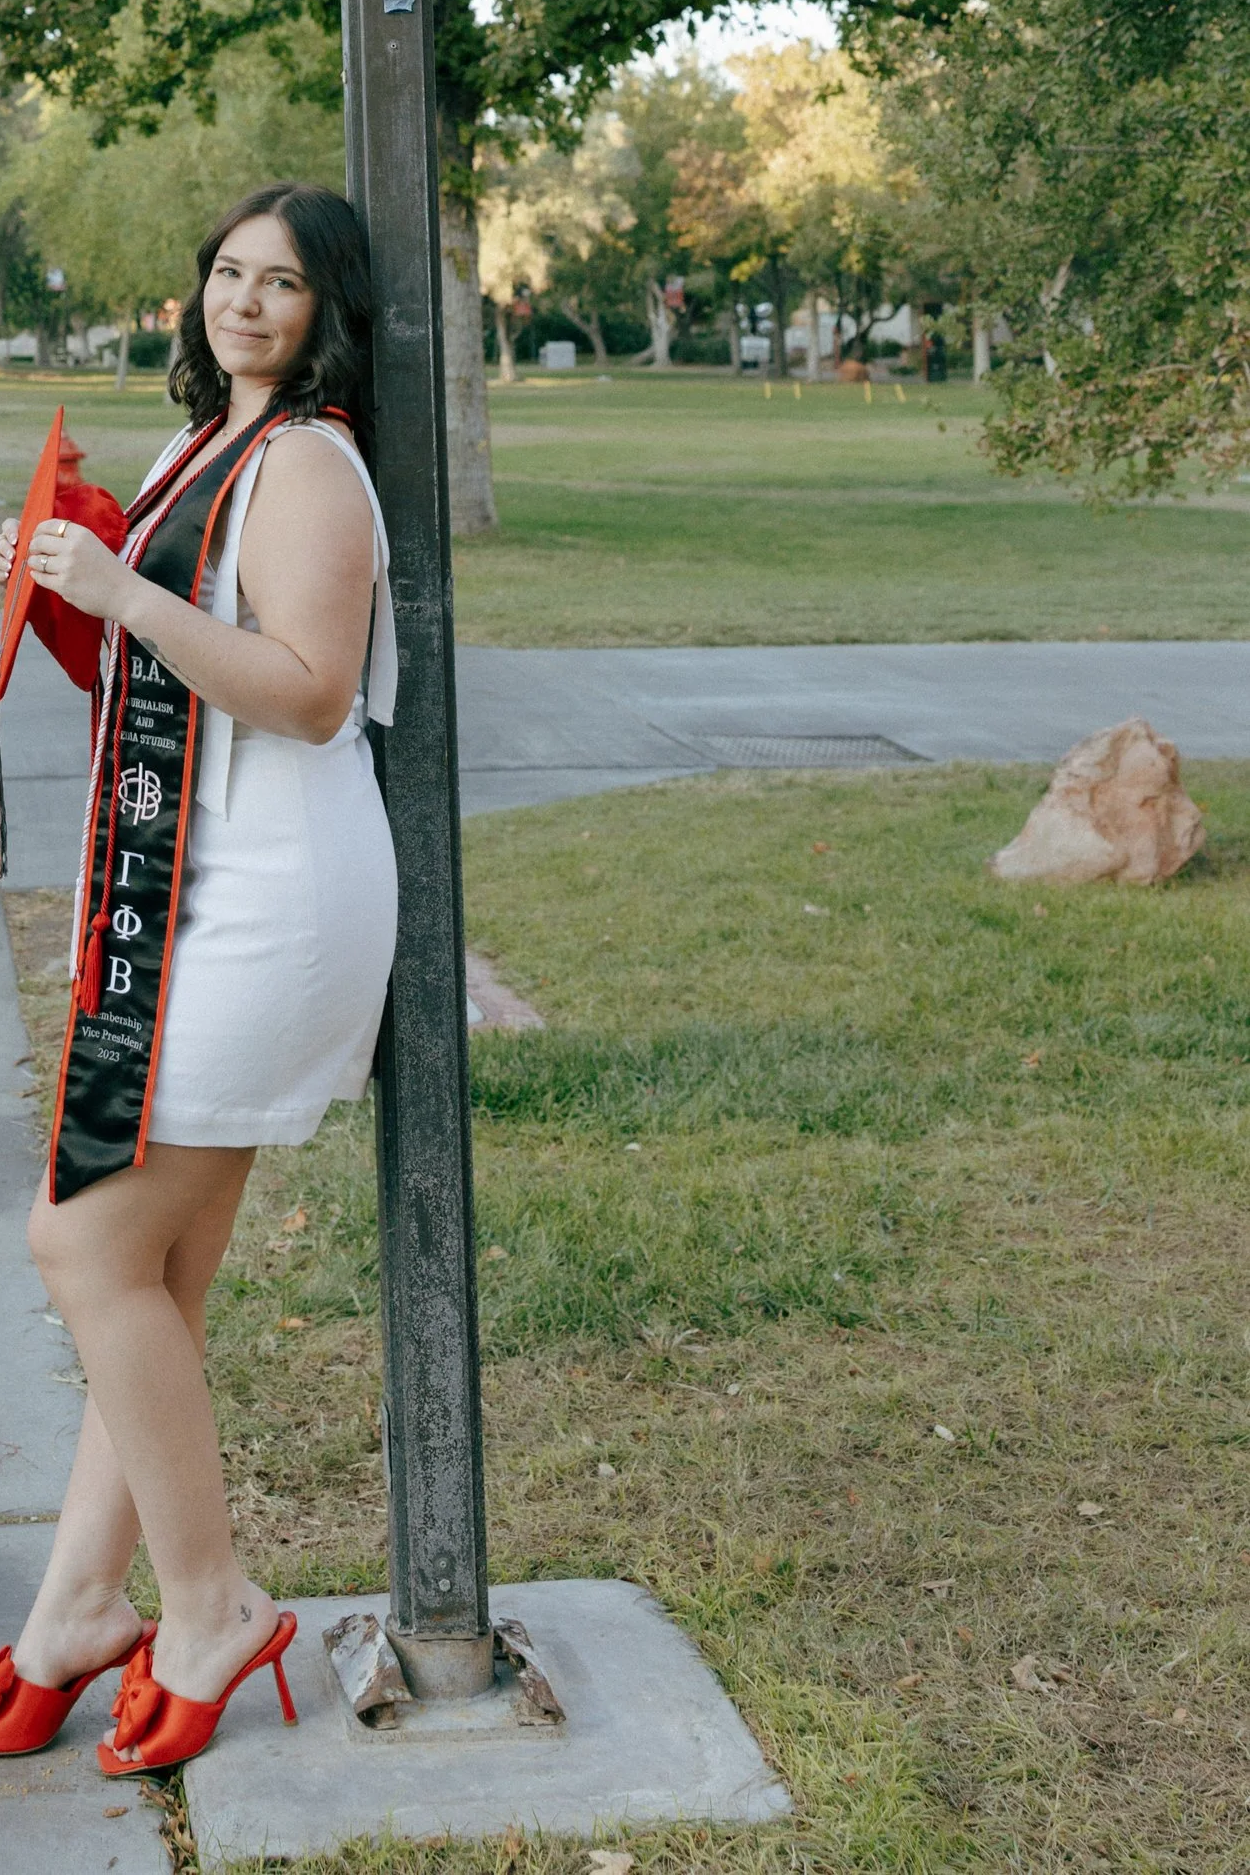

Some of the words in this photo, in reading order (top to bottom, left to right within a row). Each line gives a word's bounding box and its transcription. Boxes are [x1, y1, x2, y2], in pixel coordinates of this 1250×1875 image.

[131, 656, 165, 685] B.A.
[125, 697, 174, 714] OURNALISM
[135, 715, 154, 728] AND
[113, 729, 138, 743] EDIA
[139, 733, 176, 750] STUDIES
[82, 1026, 101, 1038] Vice
[97, 1047, 120, 1062] 2023
